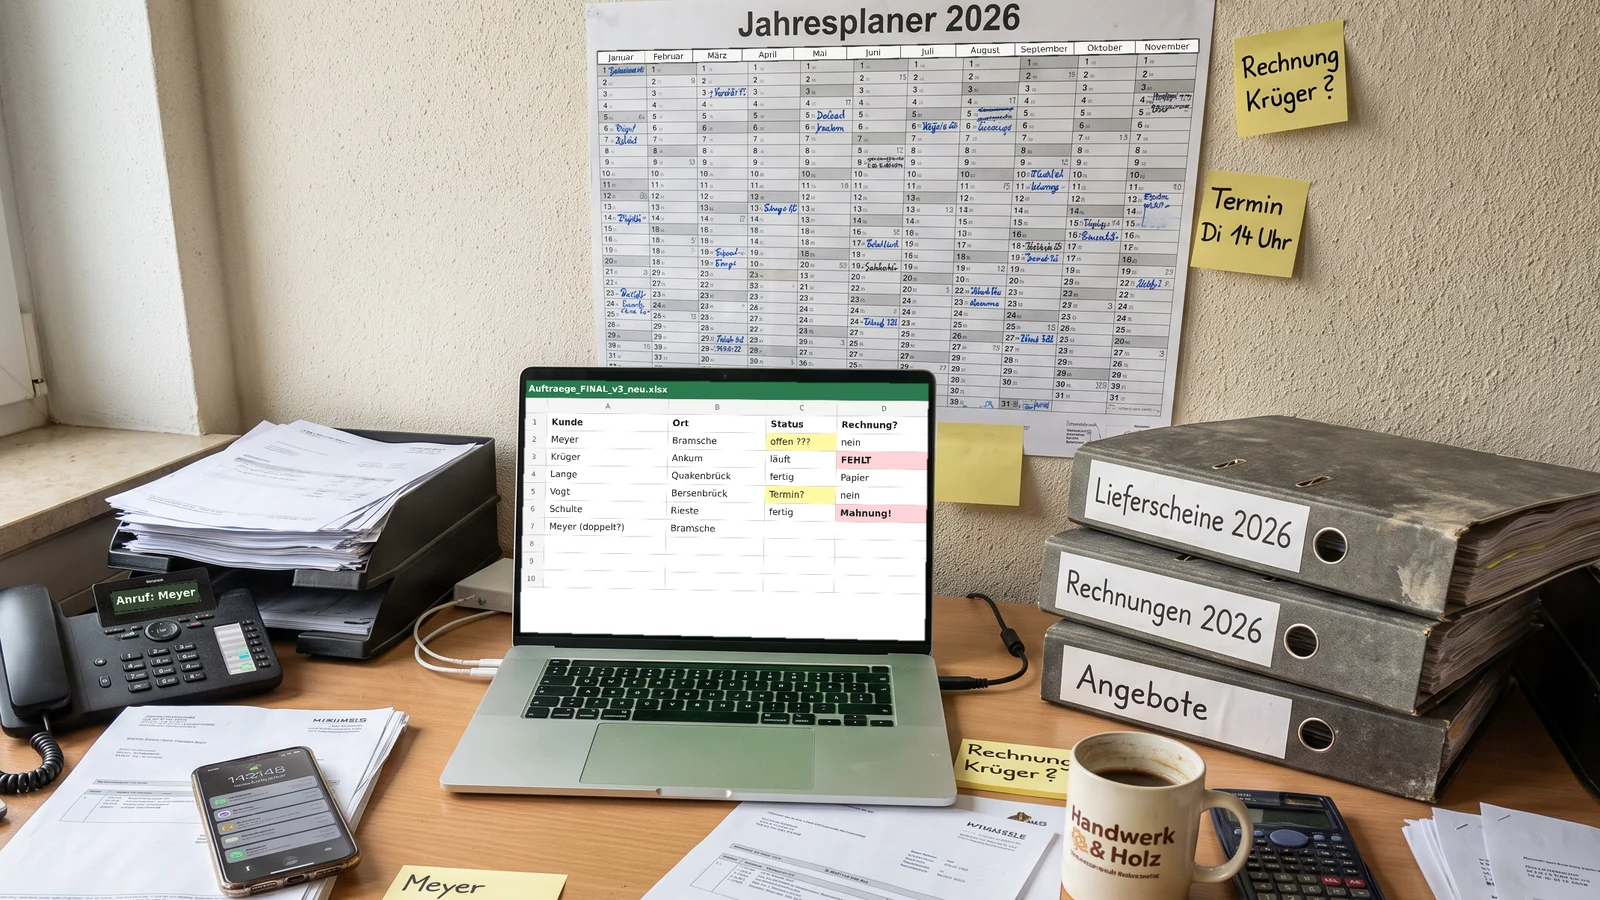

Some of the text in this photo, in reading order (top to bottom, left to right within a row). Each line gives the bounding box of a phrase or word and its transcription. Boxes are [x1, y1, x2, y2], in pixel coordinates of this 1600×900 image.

[737, 3, 1020, 41] Jahresplaner 2026
[970, 46, 1001, 56] August
[1020, 45, 1069, 55] September
[1087, 43, 1123, 52] Oktober
[1144, 42, 1191, 51] November
[653, 52, 684, 61] Februar
[707, 51, 728, 60] März
[758, 50, 778, 60] April
[812, 49, 827, 58] Mai
[865, 48, 881, 58] Juni
[920, 47, 934, 57] Juli
[1241, 50, 1339, 79] Rechnung
[1247, 75, 1334, 113] Krüger ?
[1211, 187, 1282, 215] Termin
[1201, 222, 1292, 250] Di 14 Uhr
[528, 384, 668, 395] Auftraege_FINAL_v3_neu.xlsx
[714, 403, 721, 411] B
[799, 404, 805, 412] C
[532, 418, 537, 426] 1
[551, 417, 584, 427] Kunde
[672, 418, 690, 427] Ort
[770, 419, 804, 429] Status
[841, 420, 898, 431] Rechnung?
[531, 435, 537, 443] 2
[551, 435, 579, 445] Meyer
[672, 436, 718, 445] Bramsche
[770, 437, 811, 446] offen ???
[841, 439, 861, 447] nein
[531, 452, 537, 460] 3
[550, 452, 581, 463] Krüger
[671, 453, 703, 462] Ankum
[770, 454, 791, 464] läuft
[841, 455, 872, 465] FEHLT
[550, 469, 578, 480] Lange
[671, 470, 731, 481] Quakenbrück
[769, 472, 795, 483] fertig
[840, 473, 870, 484] Papier
[530, 487, 536, 495] 5
[549, 487, 571, 498] Vogt
[671, 488, 728, 498] Bersenbrück
[768, 490, 805, 499] Termin?
[840, 491, 860, 500] nein
[530, 505, 536, 513] 6
[549, 504, 583, 514] Schulte
[670, 506, 700, 516] Rieste
[768, 507, 794, 519] fertig
[840, 508, 892, 520] Mahnung!
[1095, 477, 1291, 548] Lieferscheine 2026
[530, 522, 535, 530] 7
[549, 522, 625, 533] Meyer (doppelt?)
[670, 523, 716, 533] Bramsche
[527, 574, 536, 582] 10
[116, 589, 196, 606] Anruf: Meyer
[1066, 570, 1262, 643] Rechnungen 2026
[1076, 663, 1209, 722] Angebote
[964, 758, 1057, 782] Krüger ?
[1071, 804, 1176, 847] Handwerk
[1089, 840, 1106, 861] &
[1110, 846, 1162, 868] Holz
[402, 874, 485, 899] Meyer
